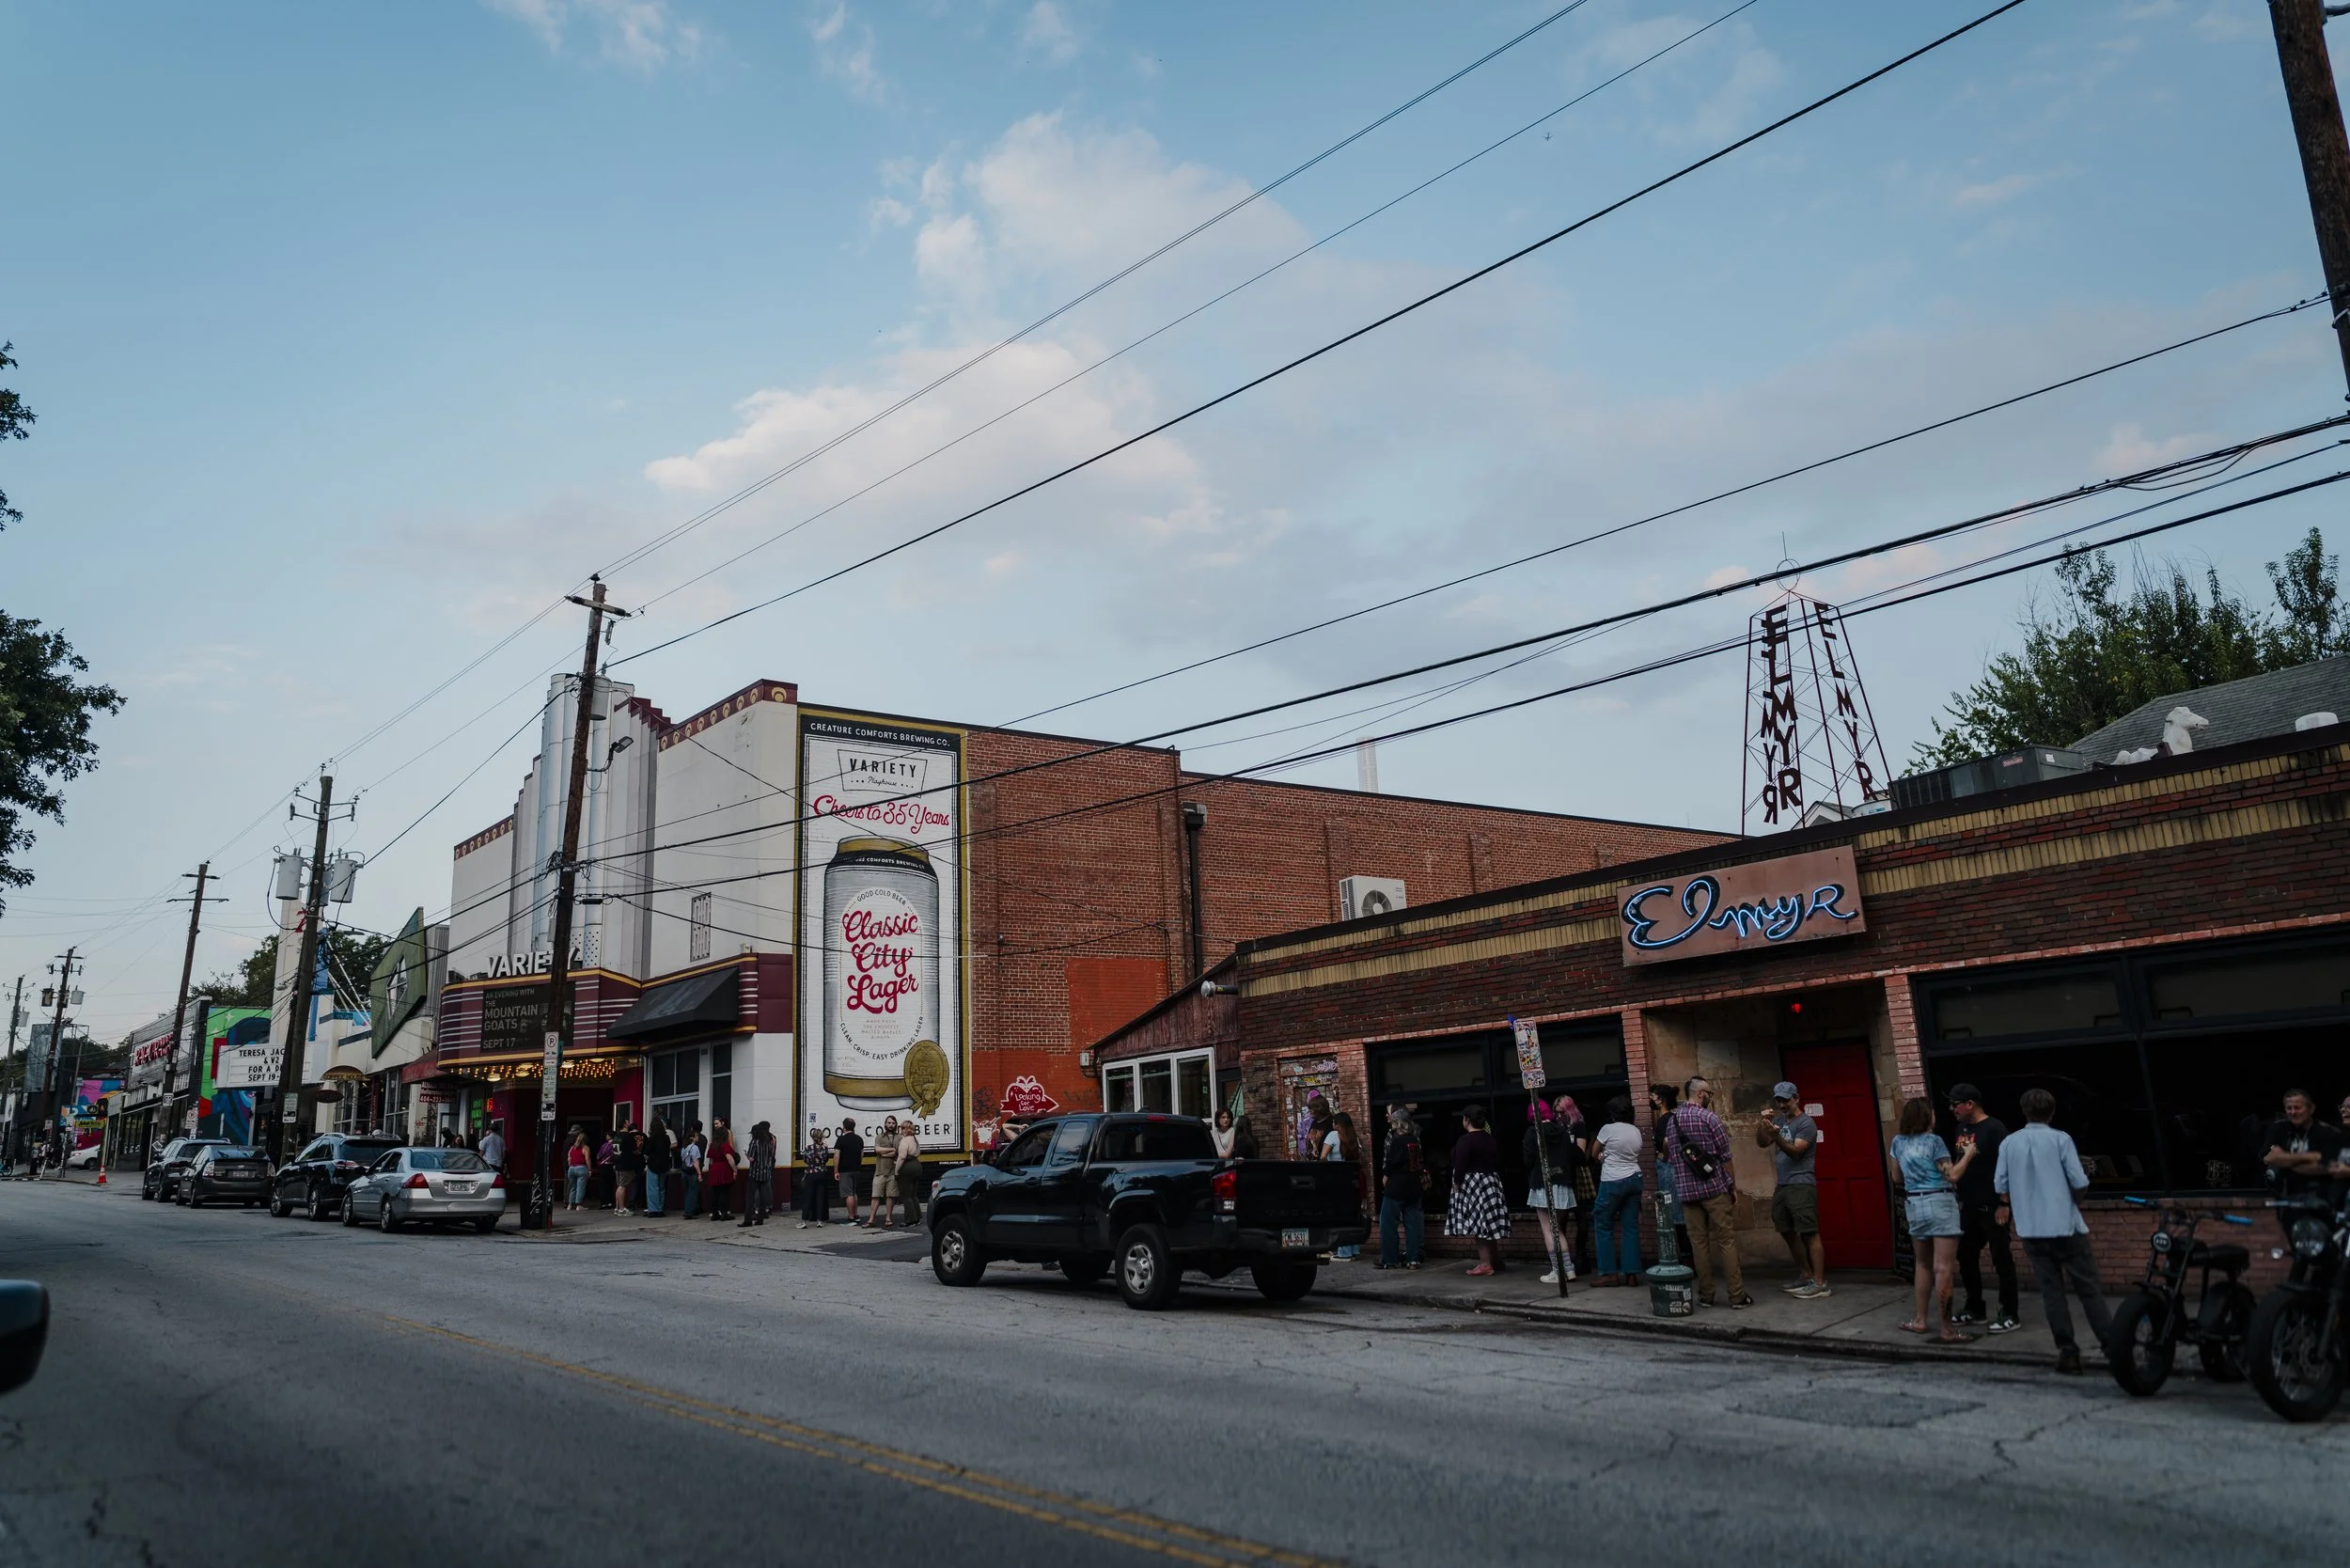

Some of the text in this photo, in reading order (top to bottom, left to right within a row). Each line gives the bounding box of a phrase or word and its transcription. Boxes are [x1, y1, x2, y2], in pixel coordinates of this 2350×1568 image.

[1766, 604, 1803, 811] ELMYR
[1814, 602, 1878, 802] ELMYR
[810, 723, 950, 747] CREATURE COMFORTS BREWING CO.
[850, 759, 916, 778] VARIETY
[867, 776, 898, 787] Playhouse
[813, 794, 949, 834] Cheers to 35 Years
[857, 888, 907, 906] GOOD COLD BEER
[842, 910, 918, 942] Classic
[488, 947, 579, 979] VARIEY
[851, 942, 914, 978] City
[494, 990, 519, 999] EVENING
[520, 988, 535, 996] WITH
[847, 974, 918, 1014] Lager
[484, 1004, 539, 1020] MOUNTAIN
[484, 1019, 518, 1031] GOATS
[482, 1038, 516, 1050] SEPT 17
[889, 1038, 916, 1059] DRINKING
[914, 1016, 924, 1037] LAGER
[239, 1048, 266, 1058] TERESA
[248, 1065, 263, 1074] FOR
[248, 1073, 280, 1082] SEPT 19-
[1014, 1093, 1041, 1104] Looking
[809, 1126, 844, 1138] OO
[914, 1123, 950, 1136] BEER
